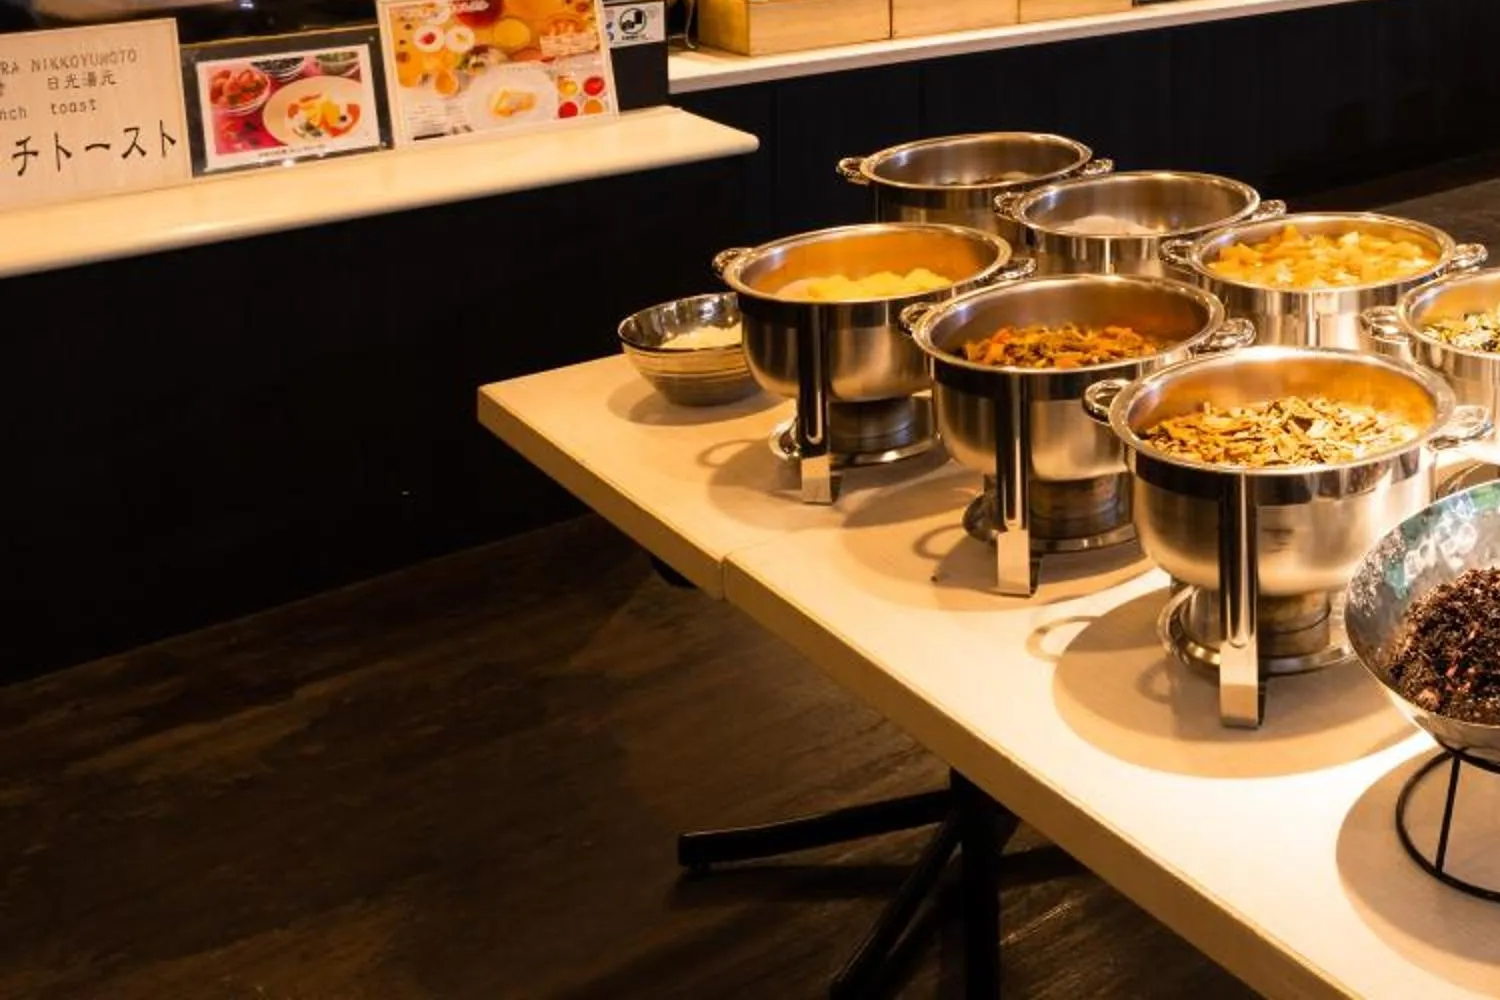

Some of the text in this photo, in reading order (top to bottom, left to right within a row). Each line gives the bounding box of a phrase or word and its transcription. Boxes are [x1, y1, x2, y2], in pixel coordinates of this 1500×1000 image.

[51, 99, 97, 115] toast
[12, 119, 177, 176] チトースト
